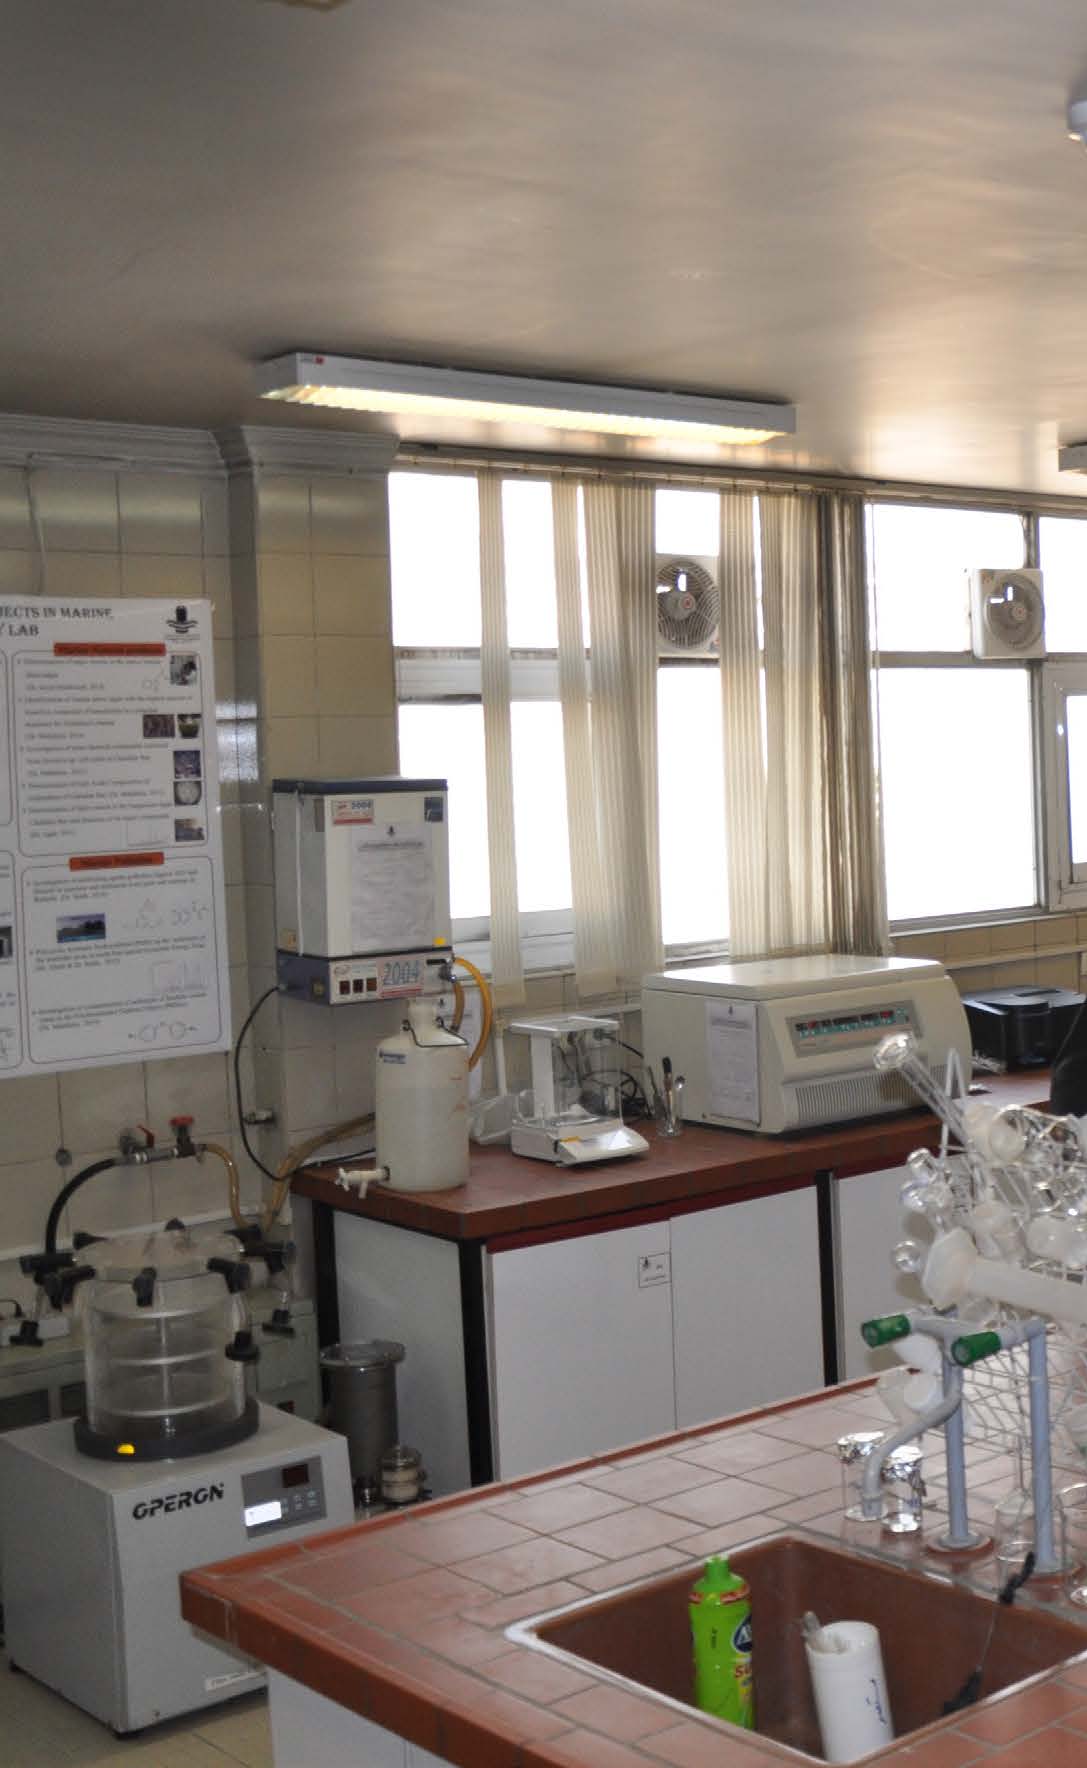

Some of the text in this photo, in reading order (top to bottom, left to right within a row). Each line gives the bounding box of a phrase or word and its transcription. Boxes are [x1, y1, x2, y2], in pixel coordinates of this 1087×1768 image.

[42, 606, 57, 618] IN
[8, 623, 39, 637] LAB
[132, 1484, 224, 1520] OPERON
